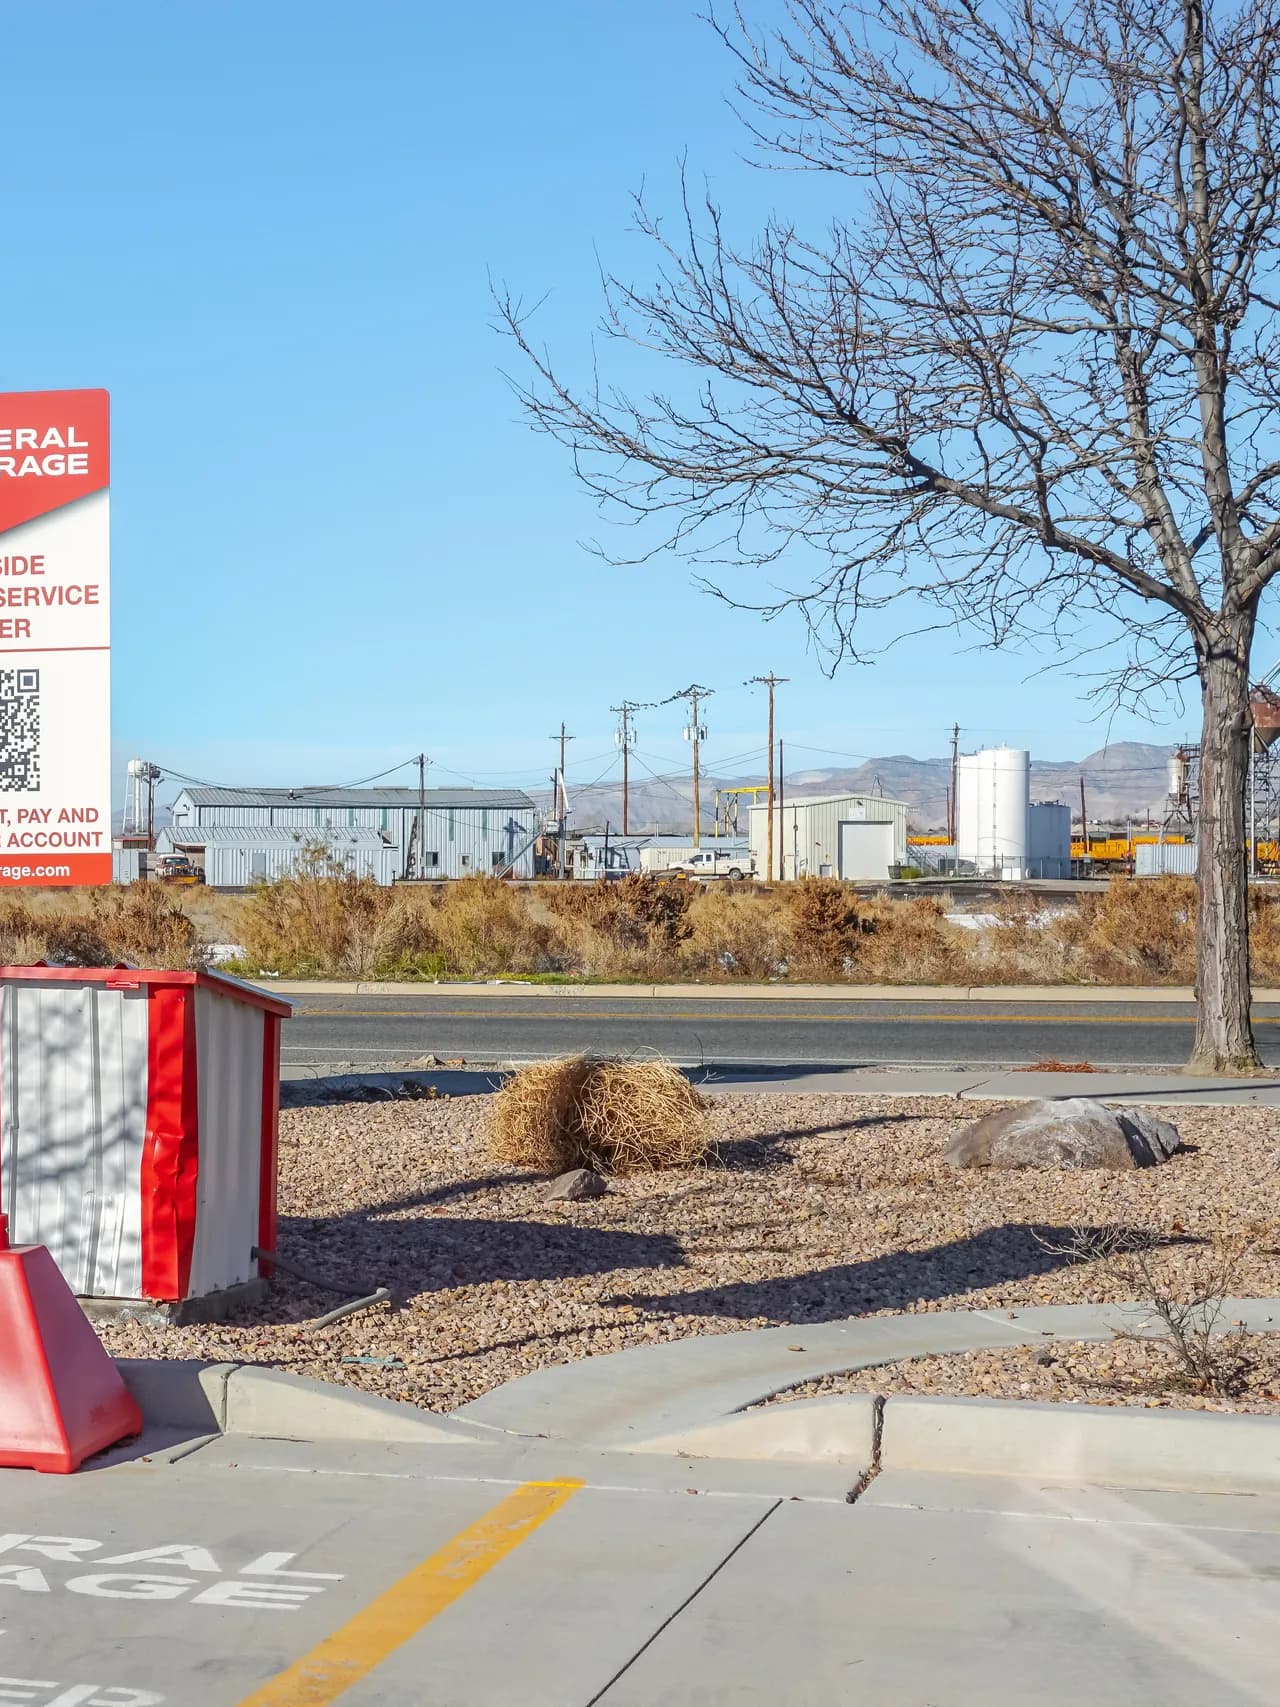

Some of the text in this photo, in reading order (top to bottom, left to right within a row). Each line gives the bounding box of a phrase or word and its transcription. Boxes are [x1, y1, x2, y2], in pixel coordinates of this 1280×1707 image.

[17, 808, 53, 824] PAY
[58, 807, 100, 823] AND
[7, 830, 103, 848] ACCOUNT
